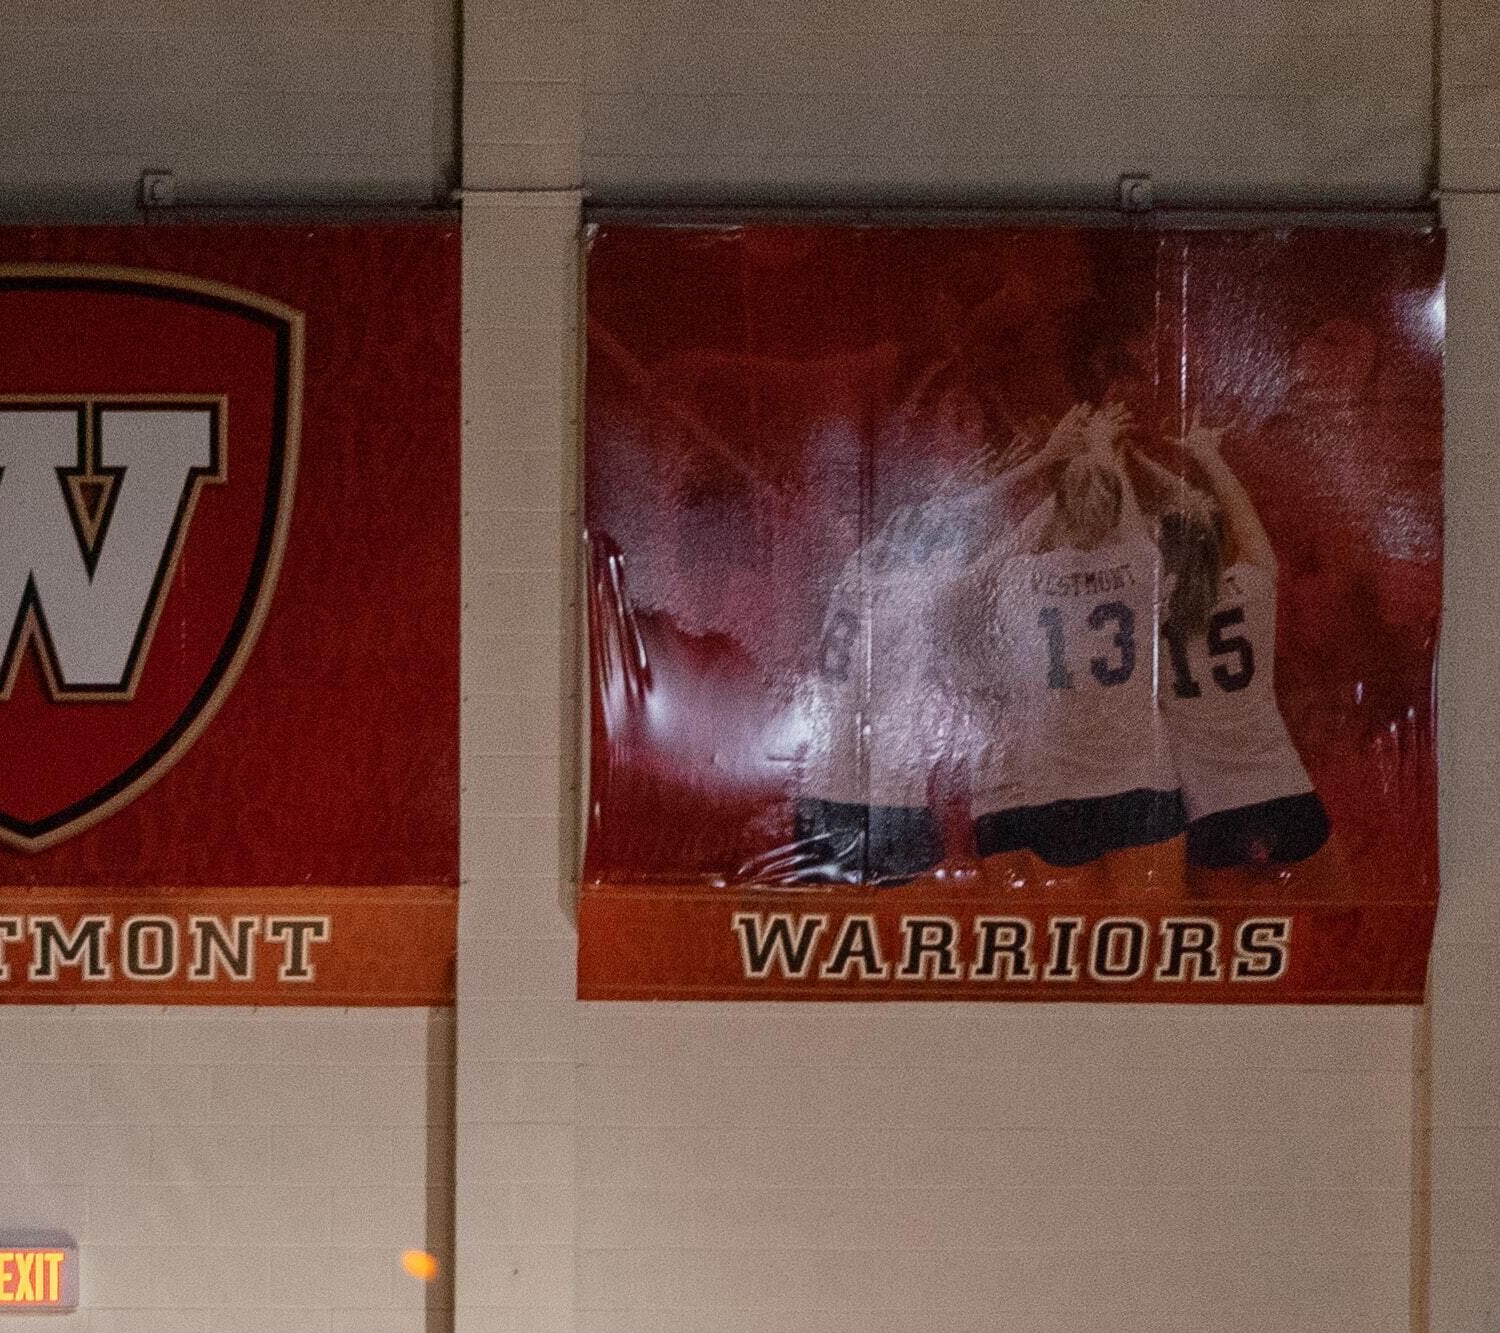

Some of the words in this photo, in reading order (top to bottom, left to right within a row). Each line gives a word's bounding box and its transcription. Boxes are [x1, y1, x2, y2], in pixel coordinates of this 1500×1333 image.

[1037, 601, 1135, 689] 13
[1161, 606, 1255, 698] 15
[733, 914, 1293, 981] WARRIORS
